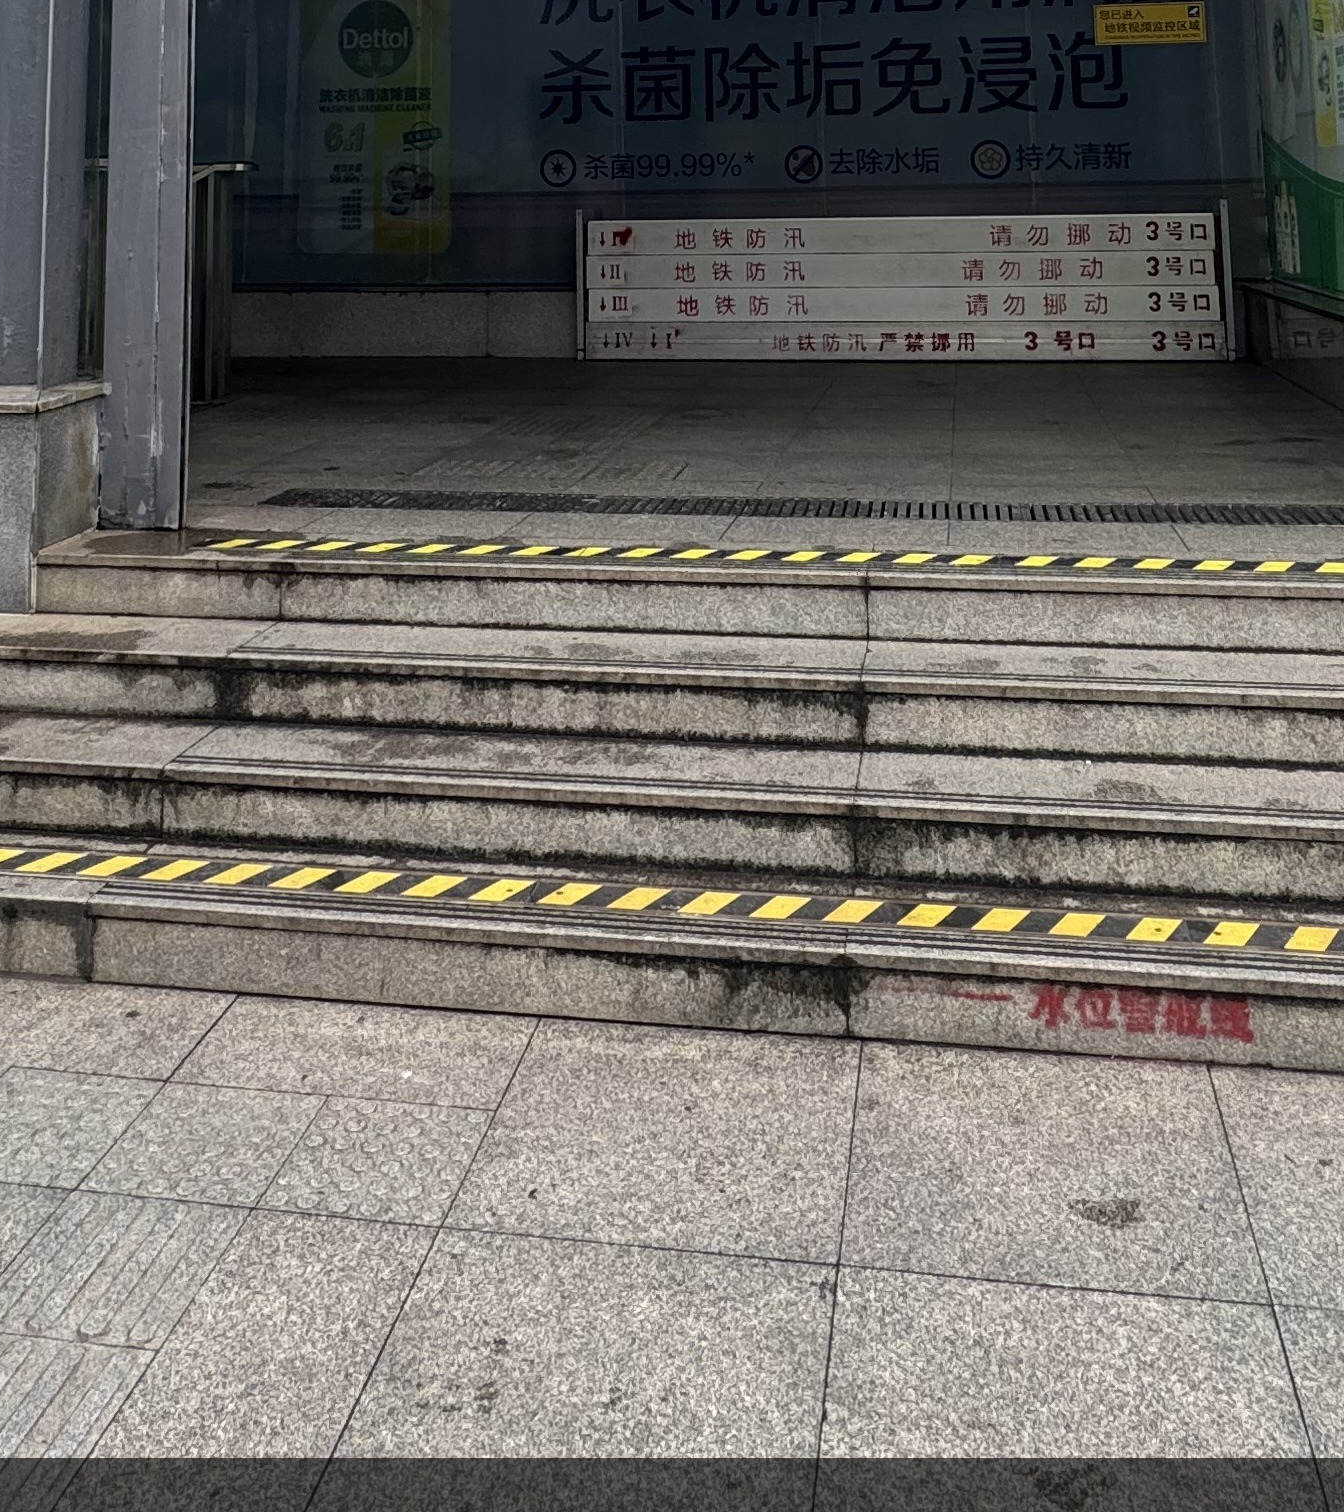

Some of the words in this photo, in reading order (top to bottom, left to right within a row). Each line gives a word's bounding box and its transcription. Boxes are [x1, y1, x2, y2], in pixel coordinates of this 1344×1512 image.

[342, 26, 408, 50] Dettol
[539, 34, 1128, 125] 杀菌除垢免浸泡
[828, 146, 940, 176] 去除水垢
[1016, 141, 1132, 171] 持久清新
[675, 228, 806, 250] 地铁防汛
[989, 222, 1132, 247] 请勿挪动
[1145, 221, 1207, 242] 3号口
[674, 260, 806, 283] 地铁防汛
[961, 256, 1104, 282] 请勿挪动
[1146, 256, 1207, 277] 3号口
[676, 294, 809, 317] 地铁防汛
[964, 292, 1109, 316] 请勿挪动
[1147, 292, 1211, 313] 3号口
[1152, 330, 1217, 352] 3号口
